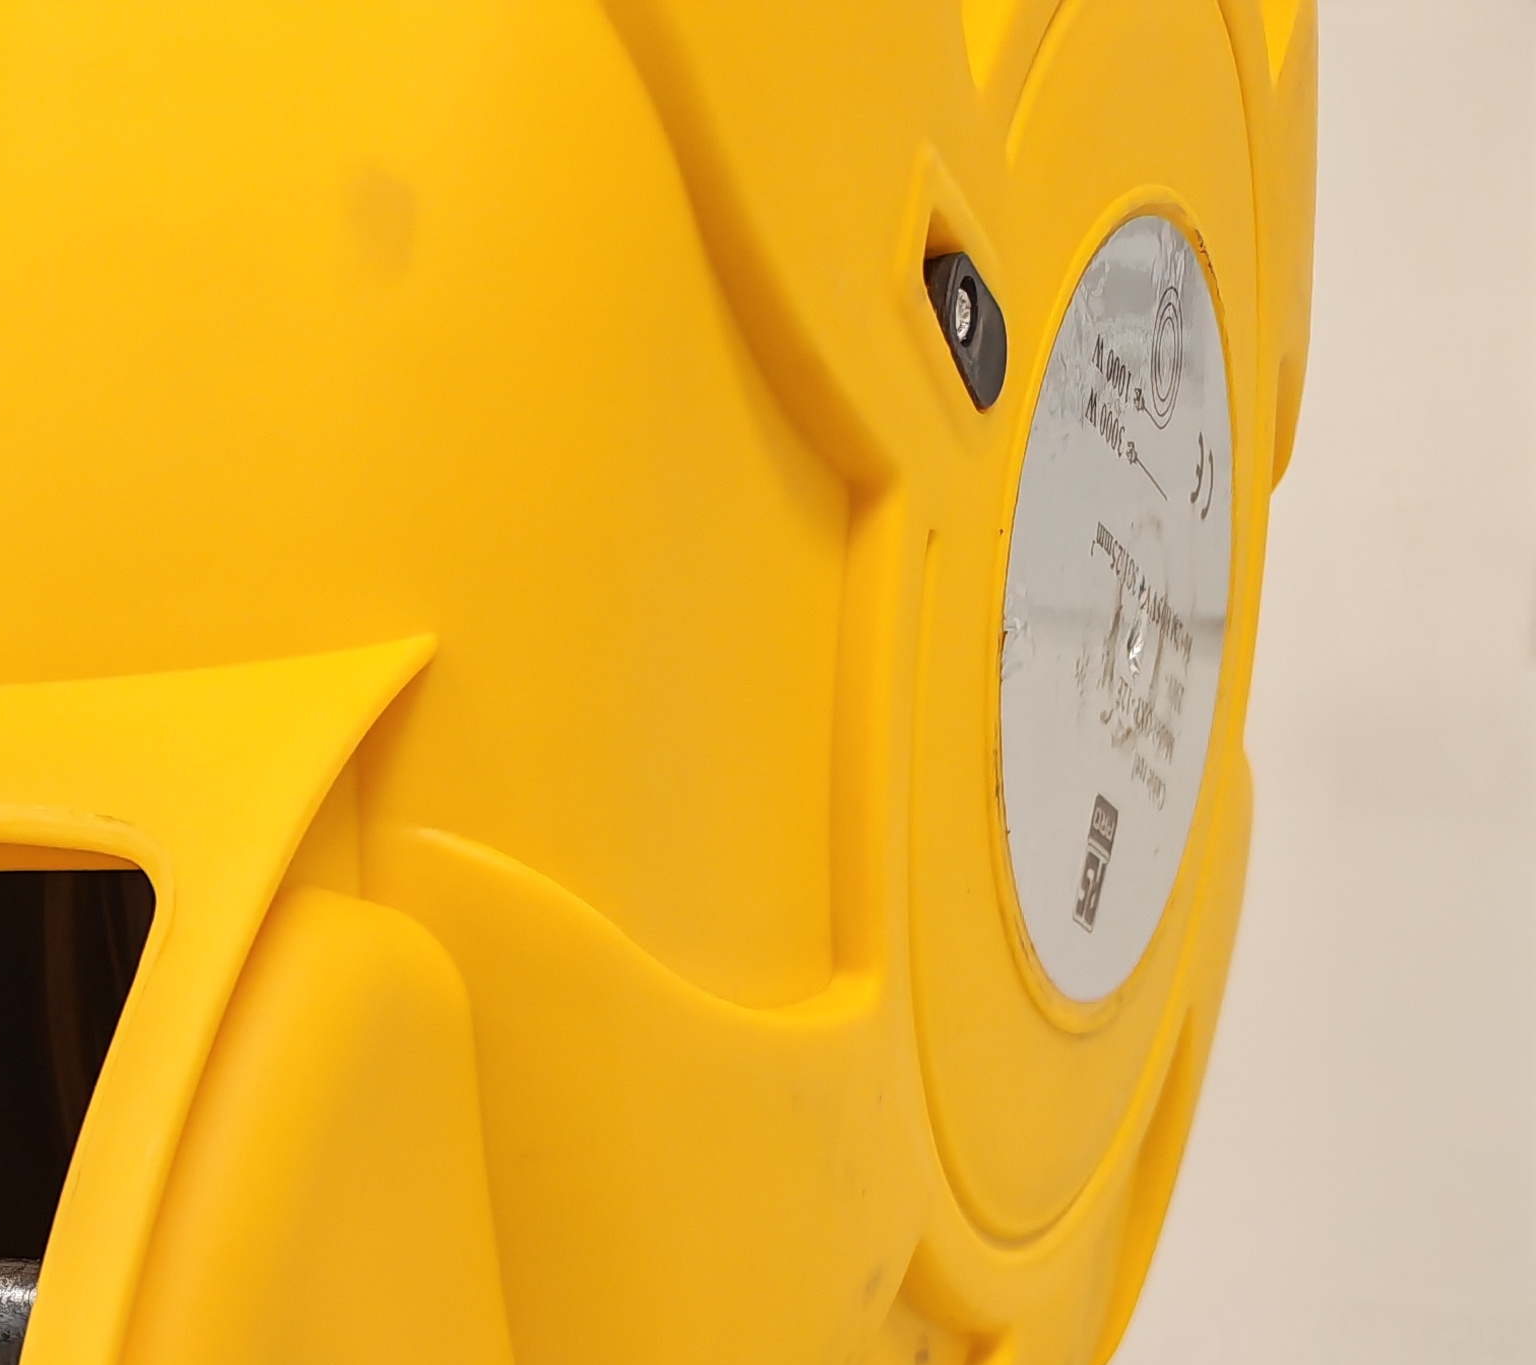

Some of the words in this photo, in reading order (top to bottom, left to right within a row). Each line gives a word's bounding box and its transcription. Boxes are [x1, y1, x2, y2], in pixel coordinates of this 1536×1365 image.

[1091, 333, 1104, 375] W
[1105, 348, 1132, 404] 1000
[1085, 388, 1097, 429] W
[1099, 403, 1125, 458] 3000
[1092, 806, 1116, 841] PRO
